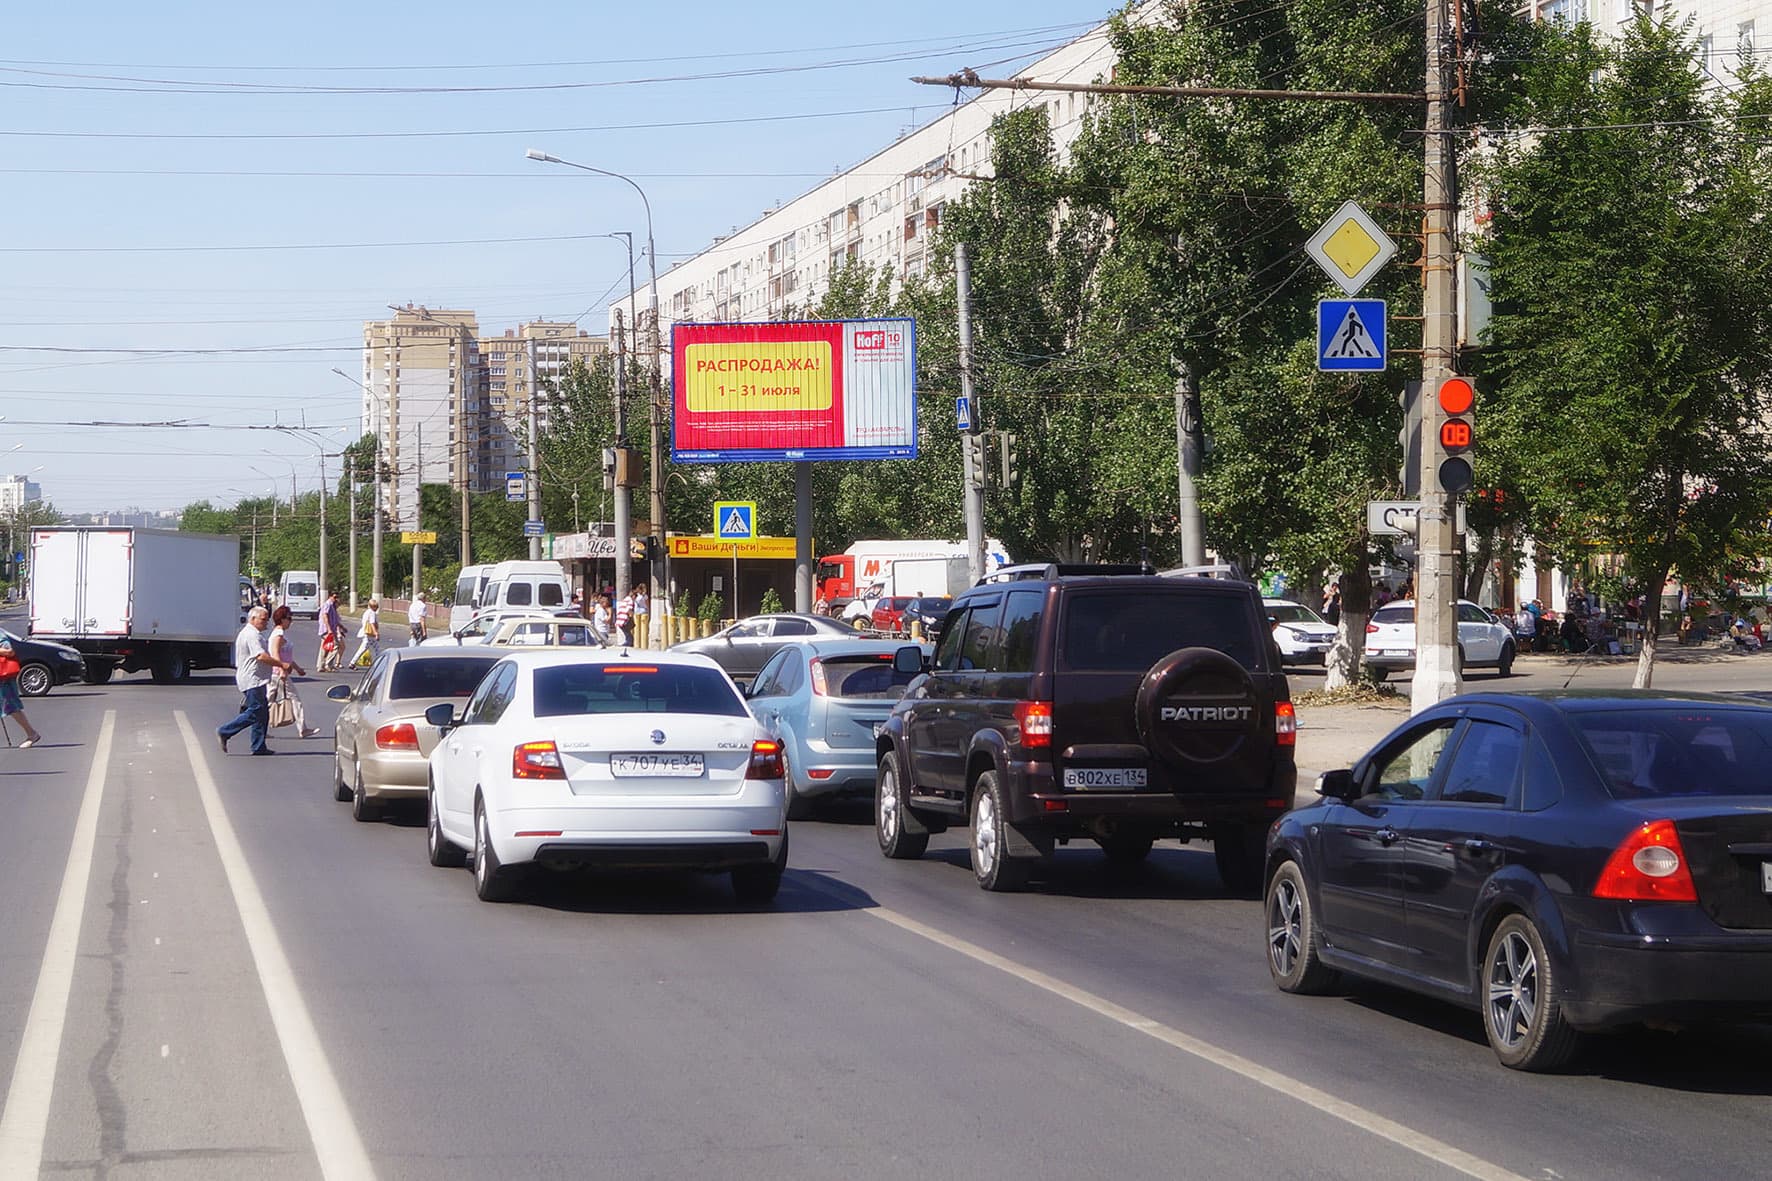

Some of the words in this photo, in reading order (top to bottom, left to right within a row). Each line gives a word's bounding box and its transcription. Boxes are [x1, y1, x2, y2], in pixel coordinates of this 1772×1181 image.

[888, 333, 901, 342] 10
[696, 358, 820, 373] РАСПРОДАЖА!
[762, 387, 800, 396] июля
[691, 542, 718, 551] Ваши
[720, 542, 756, 552] Деньги
[1161, 706, 1252, 721] PATRIOT
